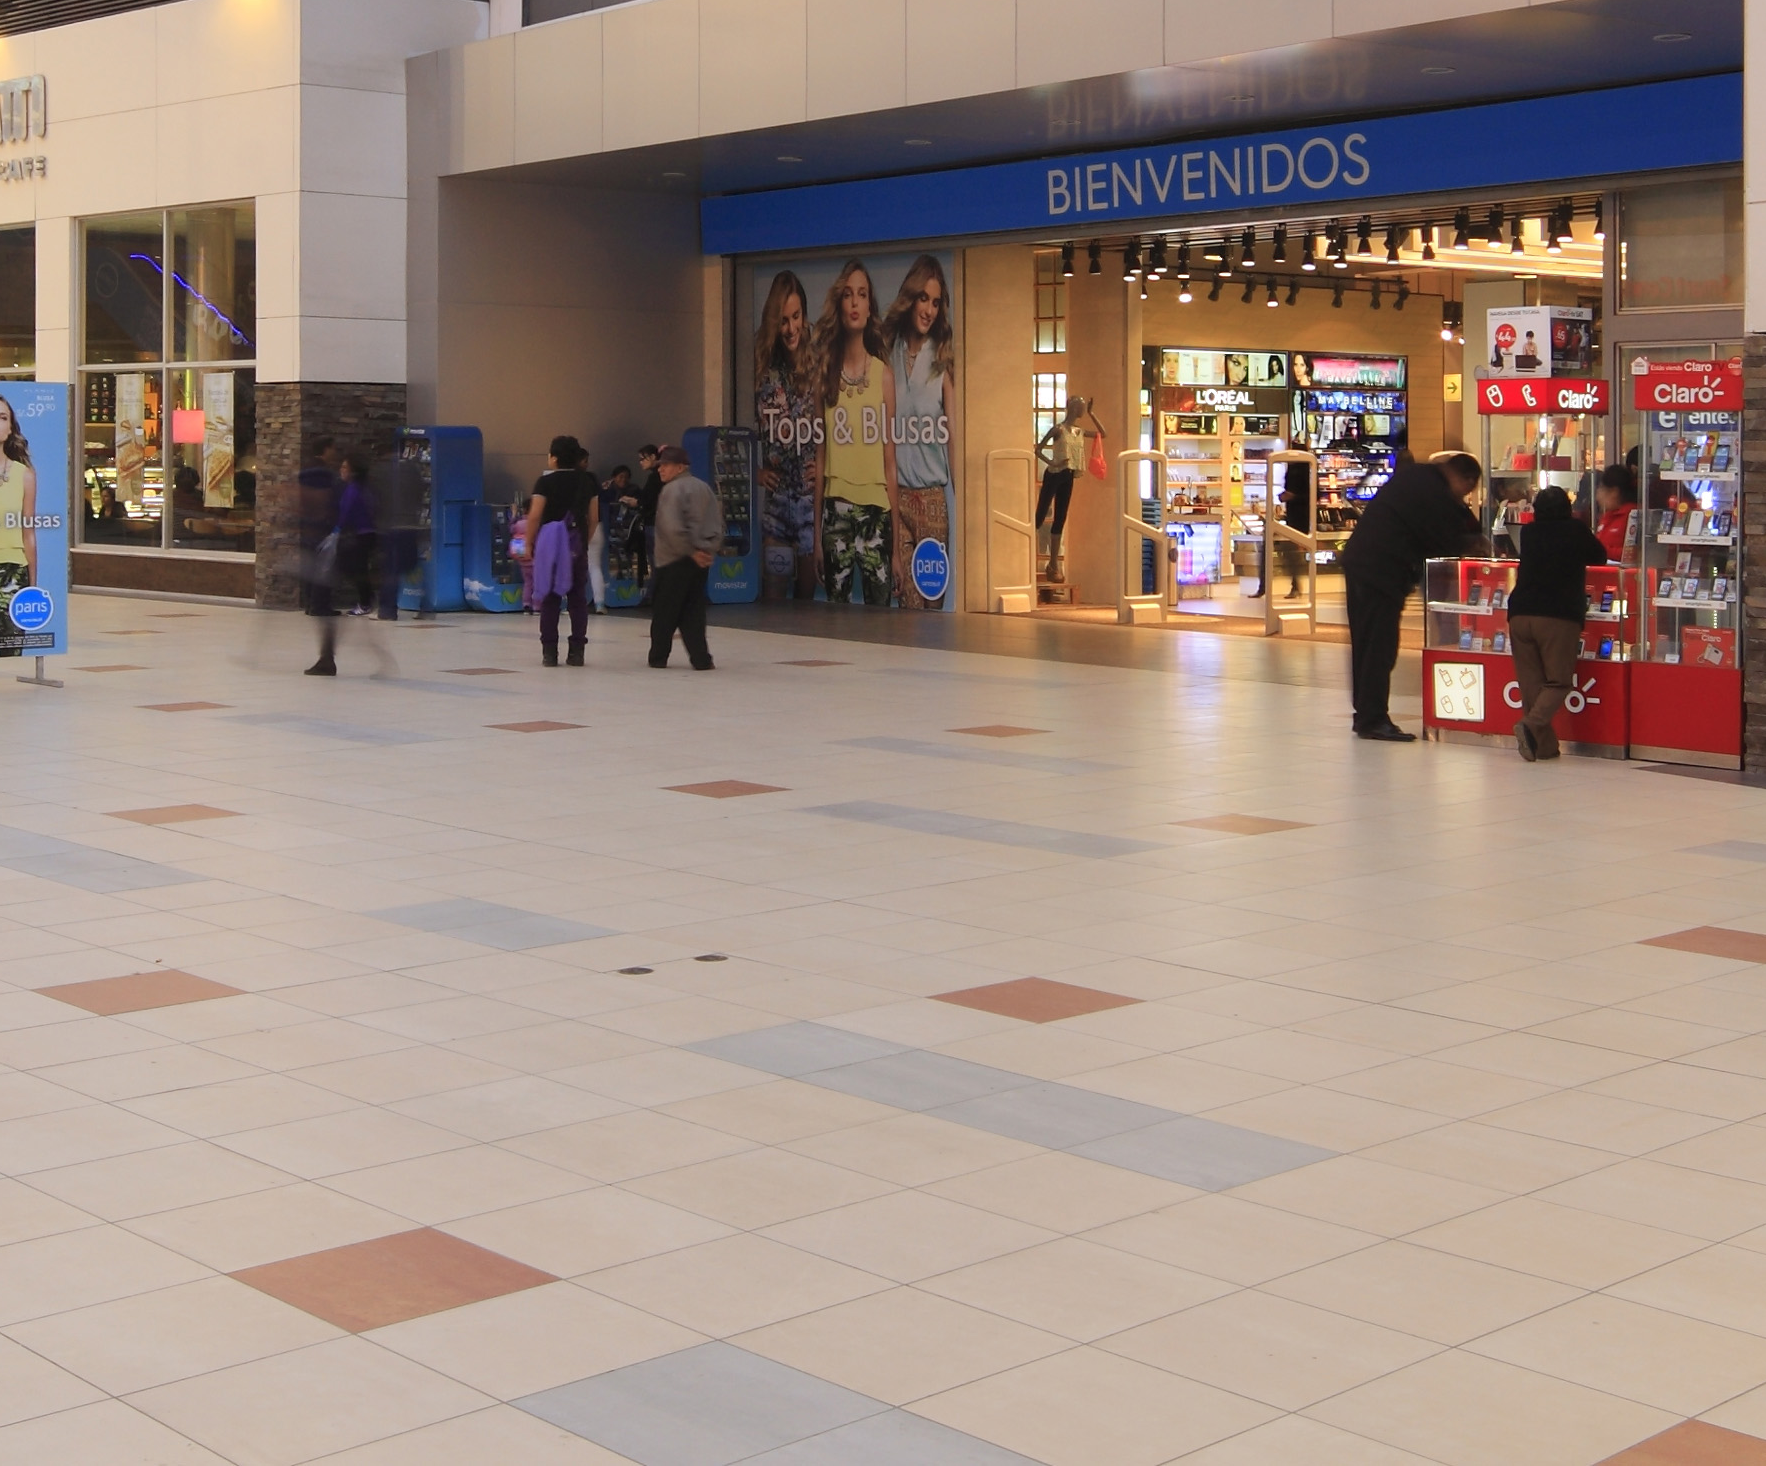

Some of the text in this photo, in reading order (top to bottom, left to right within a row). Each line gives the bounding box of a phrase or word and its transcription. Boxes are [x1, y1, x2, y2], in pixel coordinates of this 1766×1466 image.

[1047, 133, 1370, 215] BIENVENIDOS
[1558, 387, 1595, 409] Claro
[1654, 382, 1714, 404] Claro
[763, 403, 949, 456] Tops & Blusas
[5, 512, 61, 529] Blusas
[916, 558, 945, 577] paris
[714, 582, 747, 590] movistar
[15, 601, 48, 615] paris
